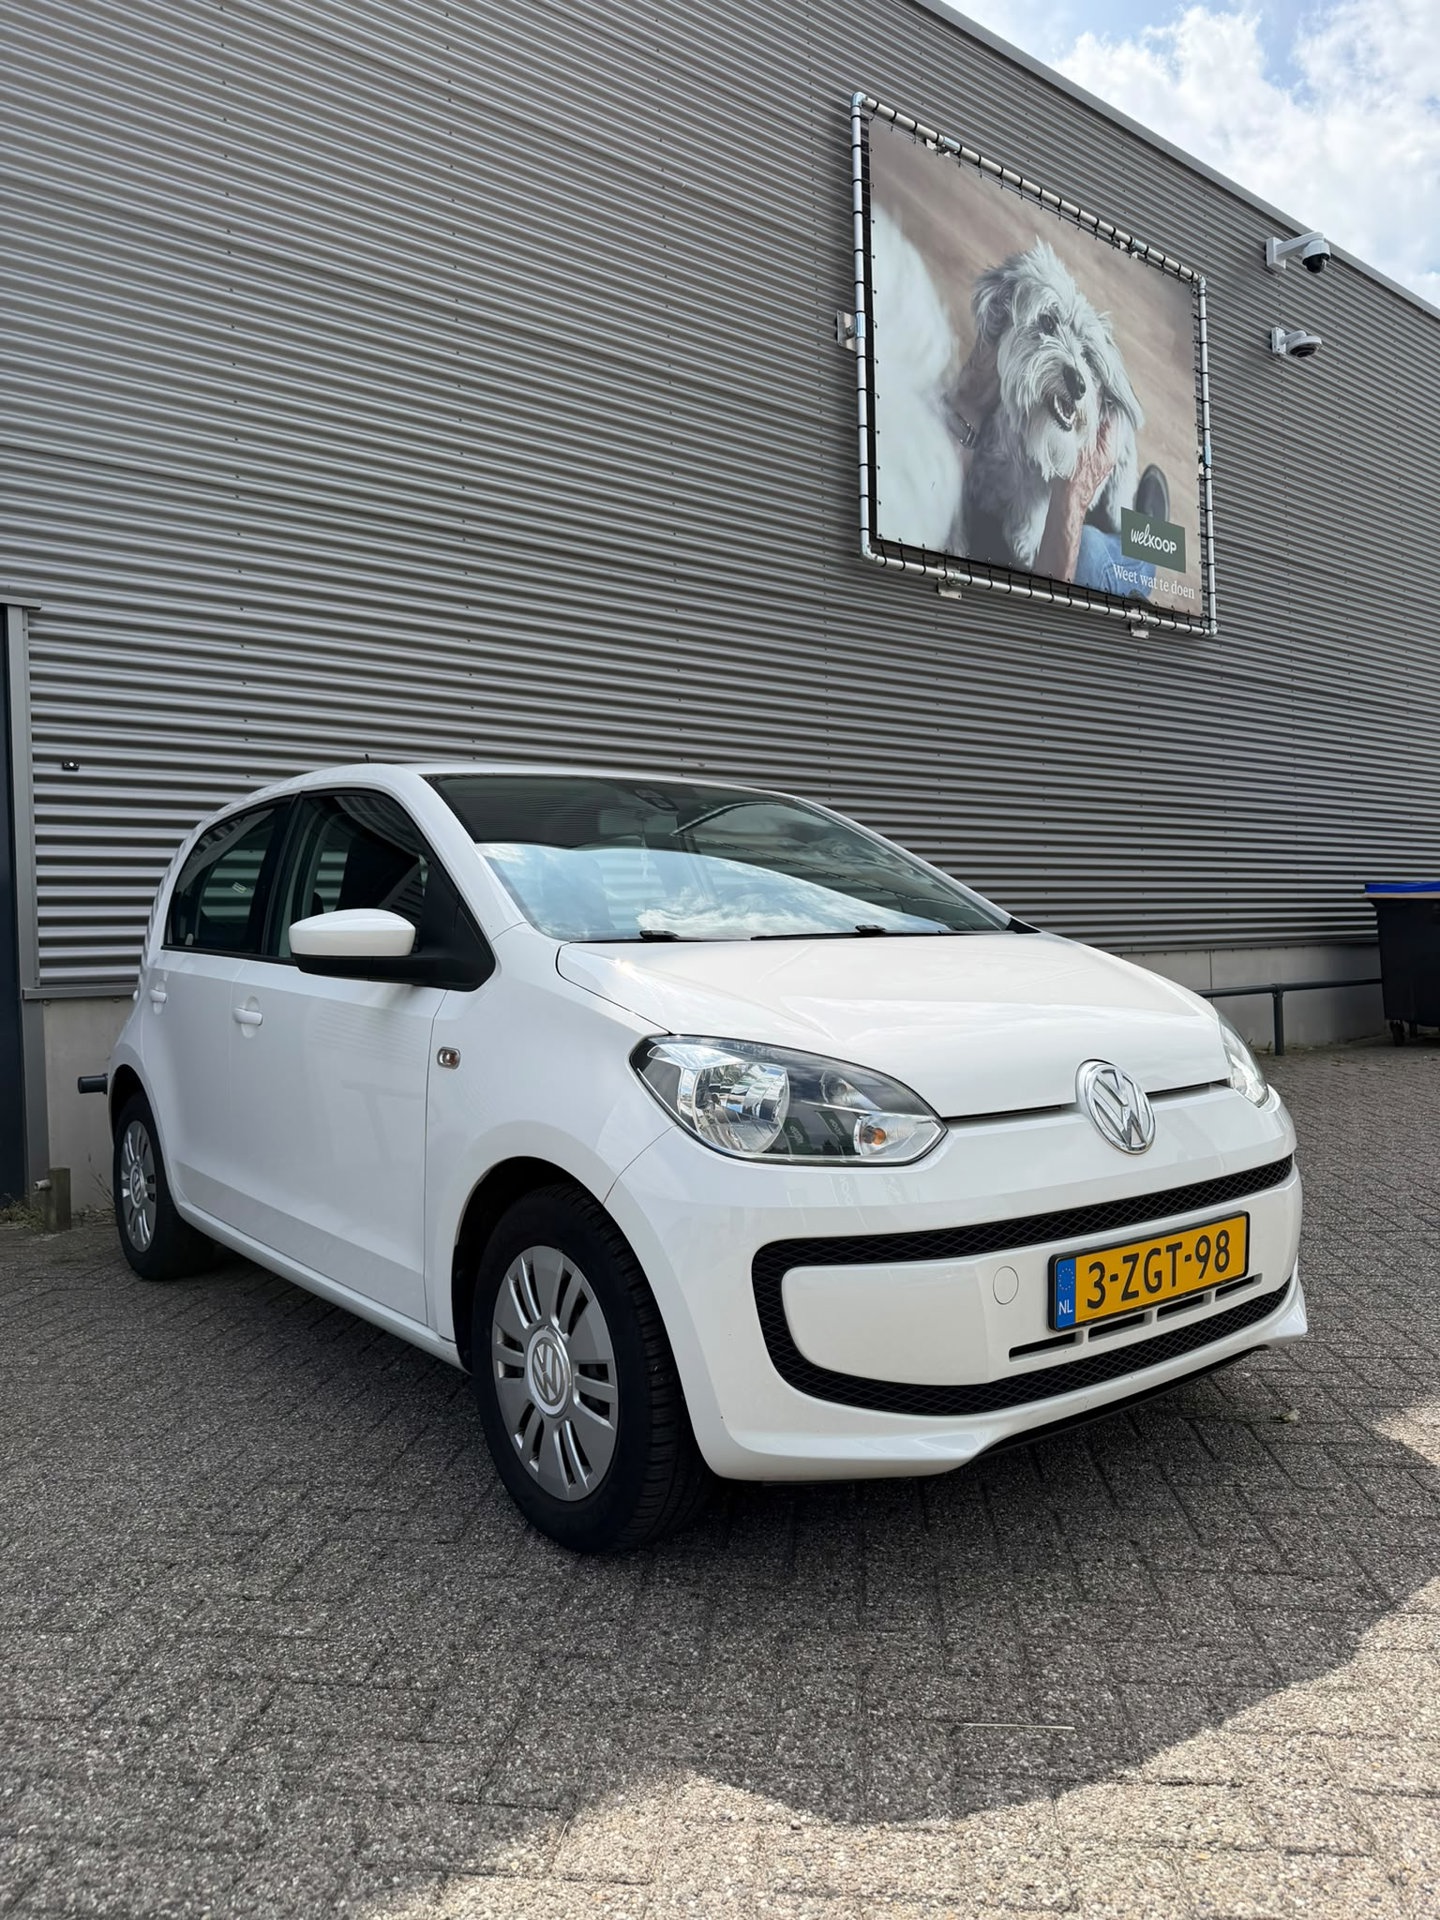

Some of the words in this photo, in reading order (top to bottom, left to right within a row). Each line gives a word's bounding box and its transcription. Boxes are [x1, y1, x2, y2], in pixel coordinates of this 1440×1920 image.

[1113, 563, 1138, 584] Weet
[1140, 573, 1158, 590] wat
[1160, 577, 1169, 592] te
[1170, 580, 1195, 599] doen
[1087, 1229, 1230, 1309] 3-ZGT-98
[1058, 1300, 1073, 1316] NL
